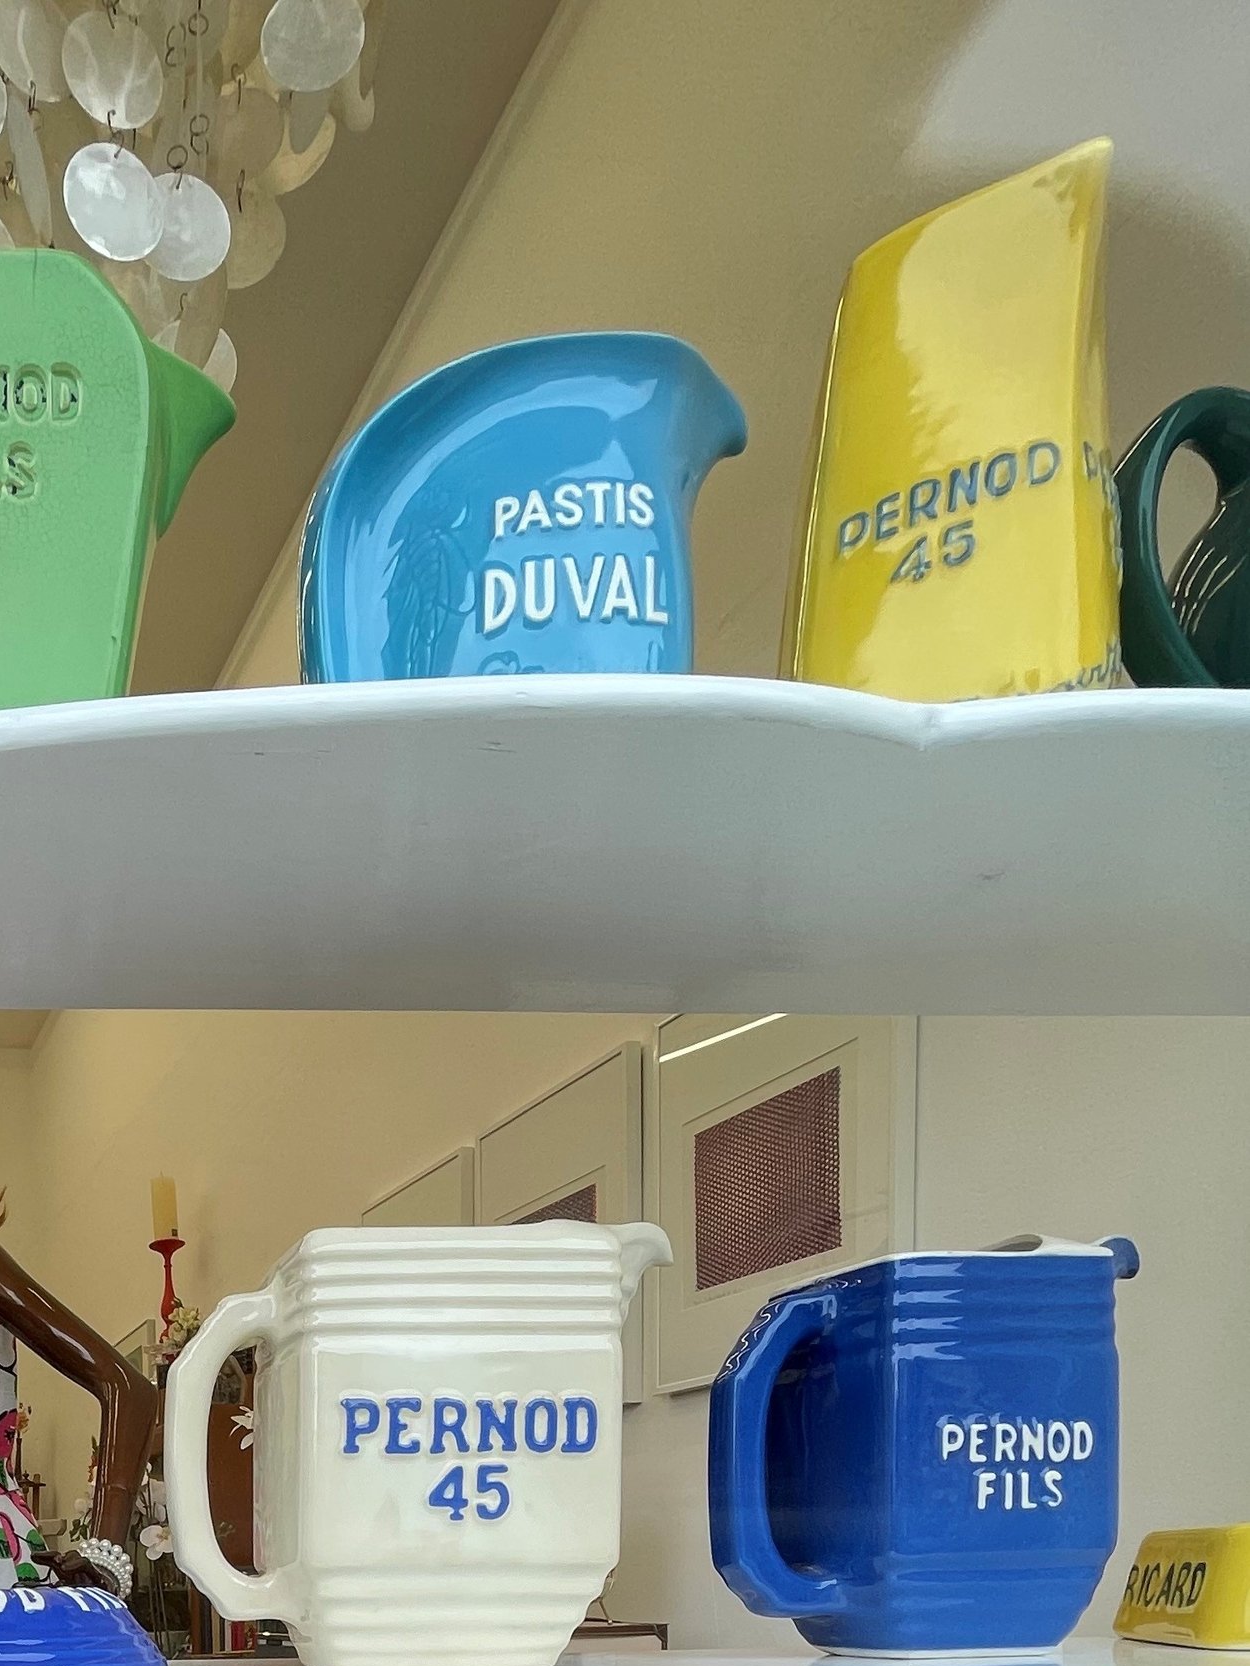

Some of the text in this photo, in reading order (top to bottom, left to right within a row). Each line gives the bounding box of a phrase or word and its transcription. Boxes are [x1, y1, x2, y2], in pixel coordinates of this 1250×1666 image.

[494, 481, 655, 538] PASTIS
[838, 441, 1061, 556] PERNOD
[890, 519, 976, 584] 45
[482, 553, 668, 635] DUVAL
[340, 1396, 598, 1455] PERNOD
[941, 1421, 1094, 1463] PERNOD
[427, 1464, 511, 1521] 45
[977, 1470, 1064, 1510] FILS
[55, 1586, 129, 1612] FIL
[1123, 1561, 1207, 1608] RICARD
